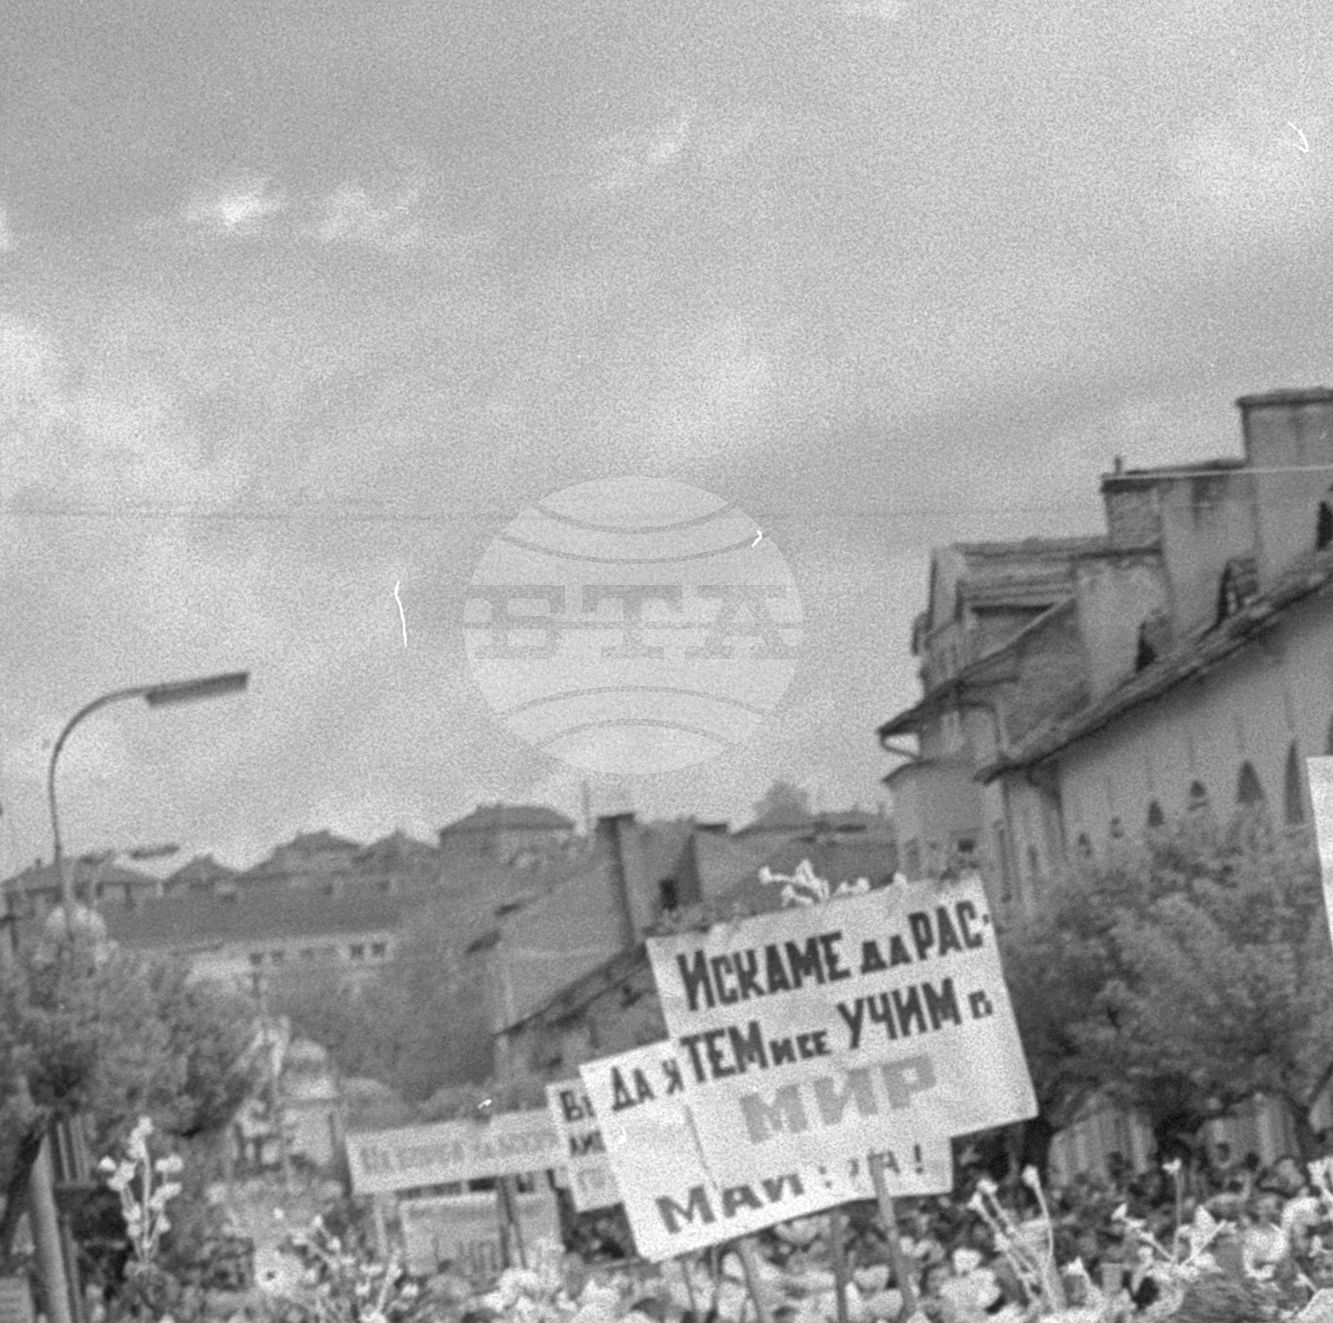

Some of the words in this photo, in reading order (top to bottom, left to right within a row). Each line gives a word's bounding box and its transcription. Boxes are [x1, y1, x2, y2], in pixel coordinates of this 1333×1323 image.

[677, 930, 851, 1012] ИСКАМЕ
[678, 1019, 769, 1085] ТЕМ
[836, 977, 963, 1049] УЧИМ
[738, 1052, 938, 1146] МИР
